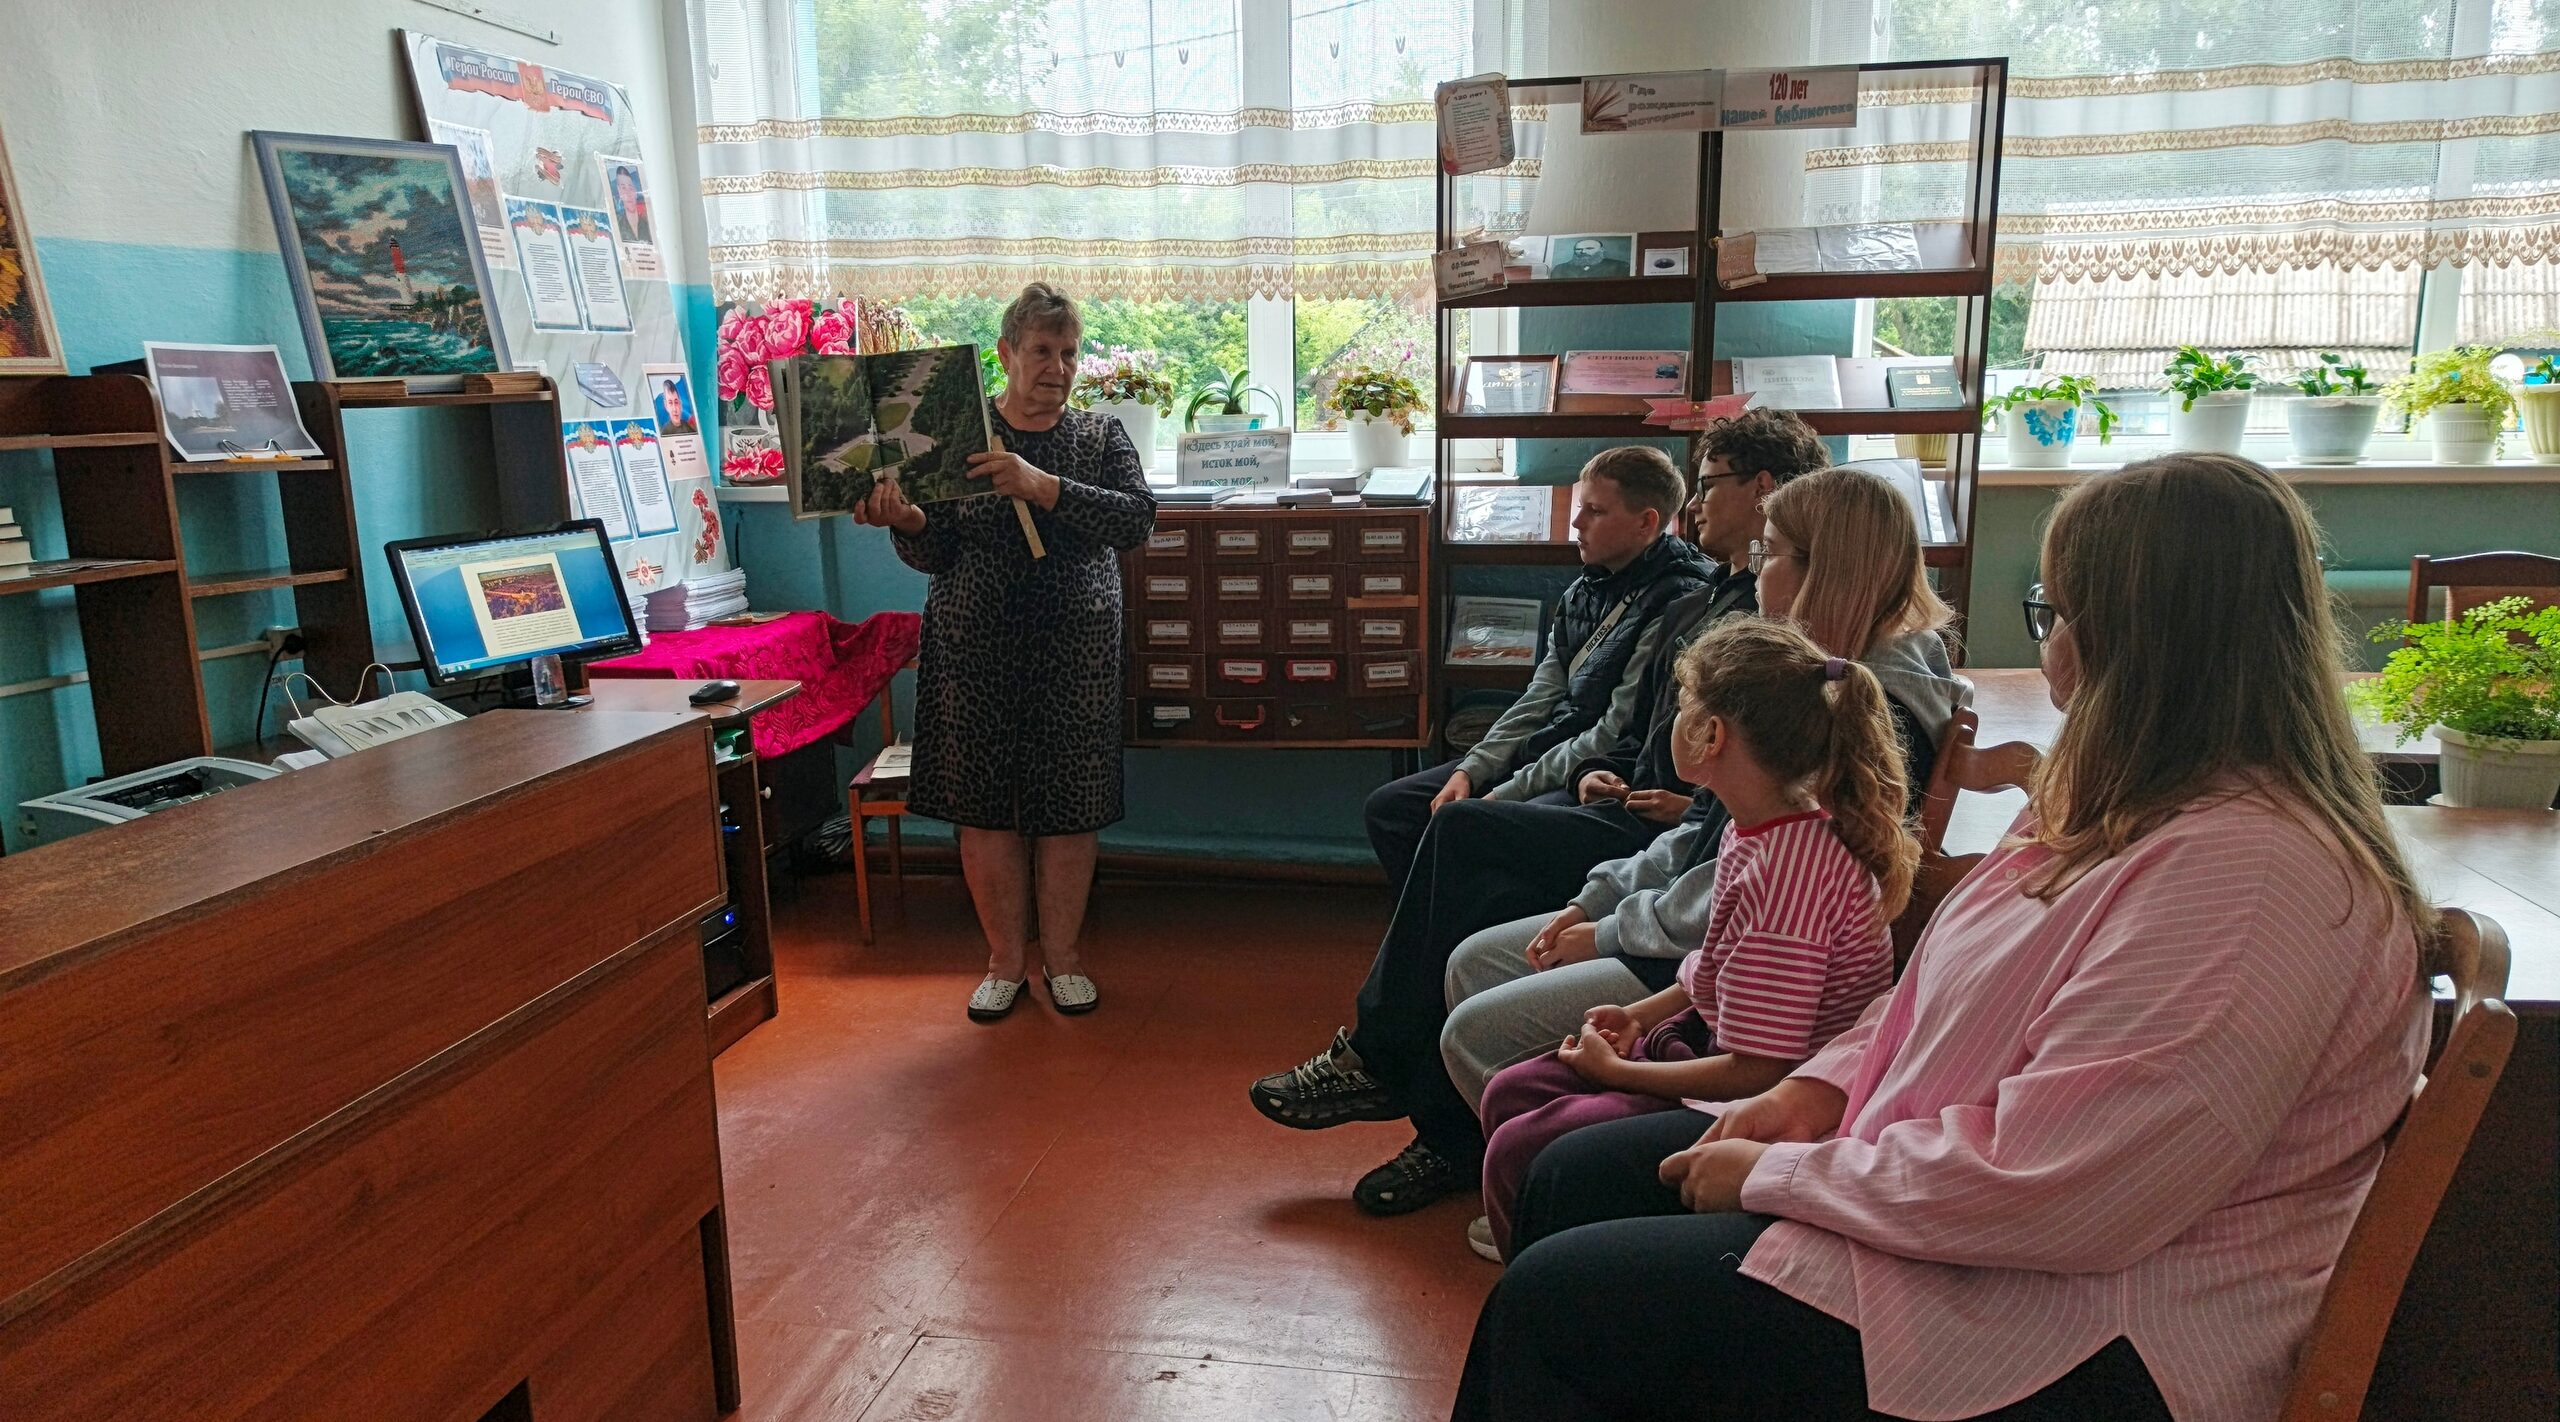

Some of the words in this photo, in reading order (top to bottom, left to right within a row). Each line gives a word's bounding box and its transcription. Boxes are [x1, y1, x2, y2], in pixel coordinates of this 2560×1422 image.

[450, 56, 480, 77] Герои
[481, 63, 515, 84] России
[550, 79, 582, 101] Герои
[584, 90, 605, 105] СВО
[1628, 83, 1656, 97] Где
[1769, 73, 1788, 101] 120
[1789, 79, 1809, 101] лет
[1721, 108, 1768, 126] нашей
[1774, 102, 1855, 125] библиотеке
[1186, 439, 1222, 453] «Здесь
[1223, 437, 1251, 453] край
[1253, 436, 1279, 449] мой,
[1201, 458, 1233, 469] исток
[1234, 454, 1260, 468] мой,
[1585, 625, 1608, 652] DICKIES
